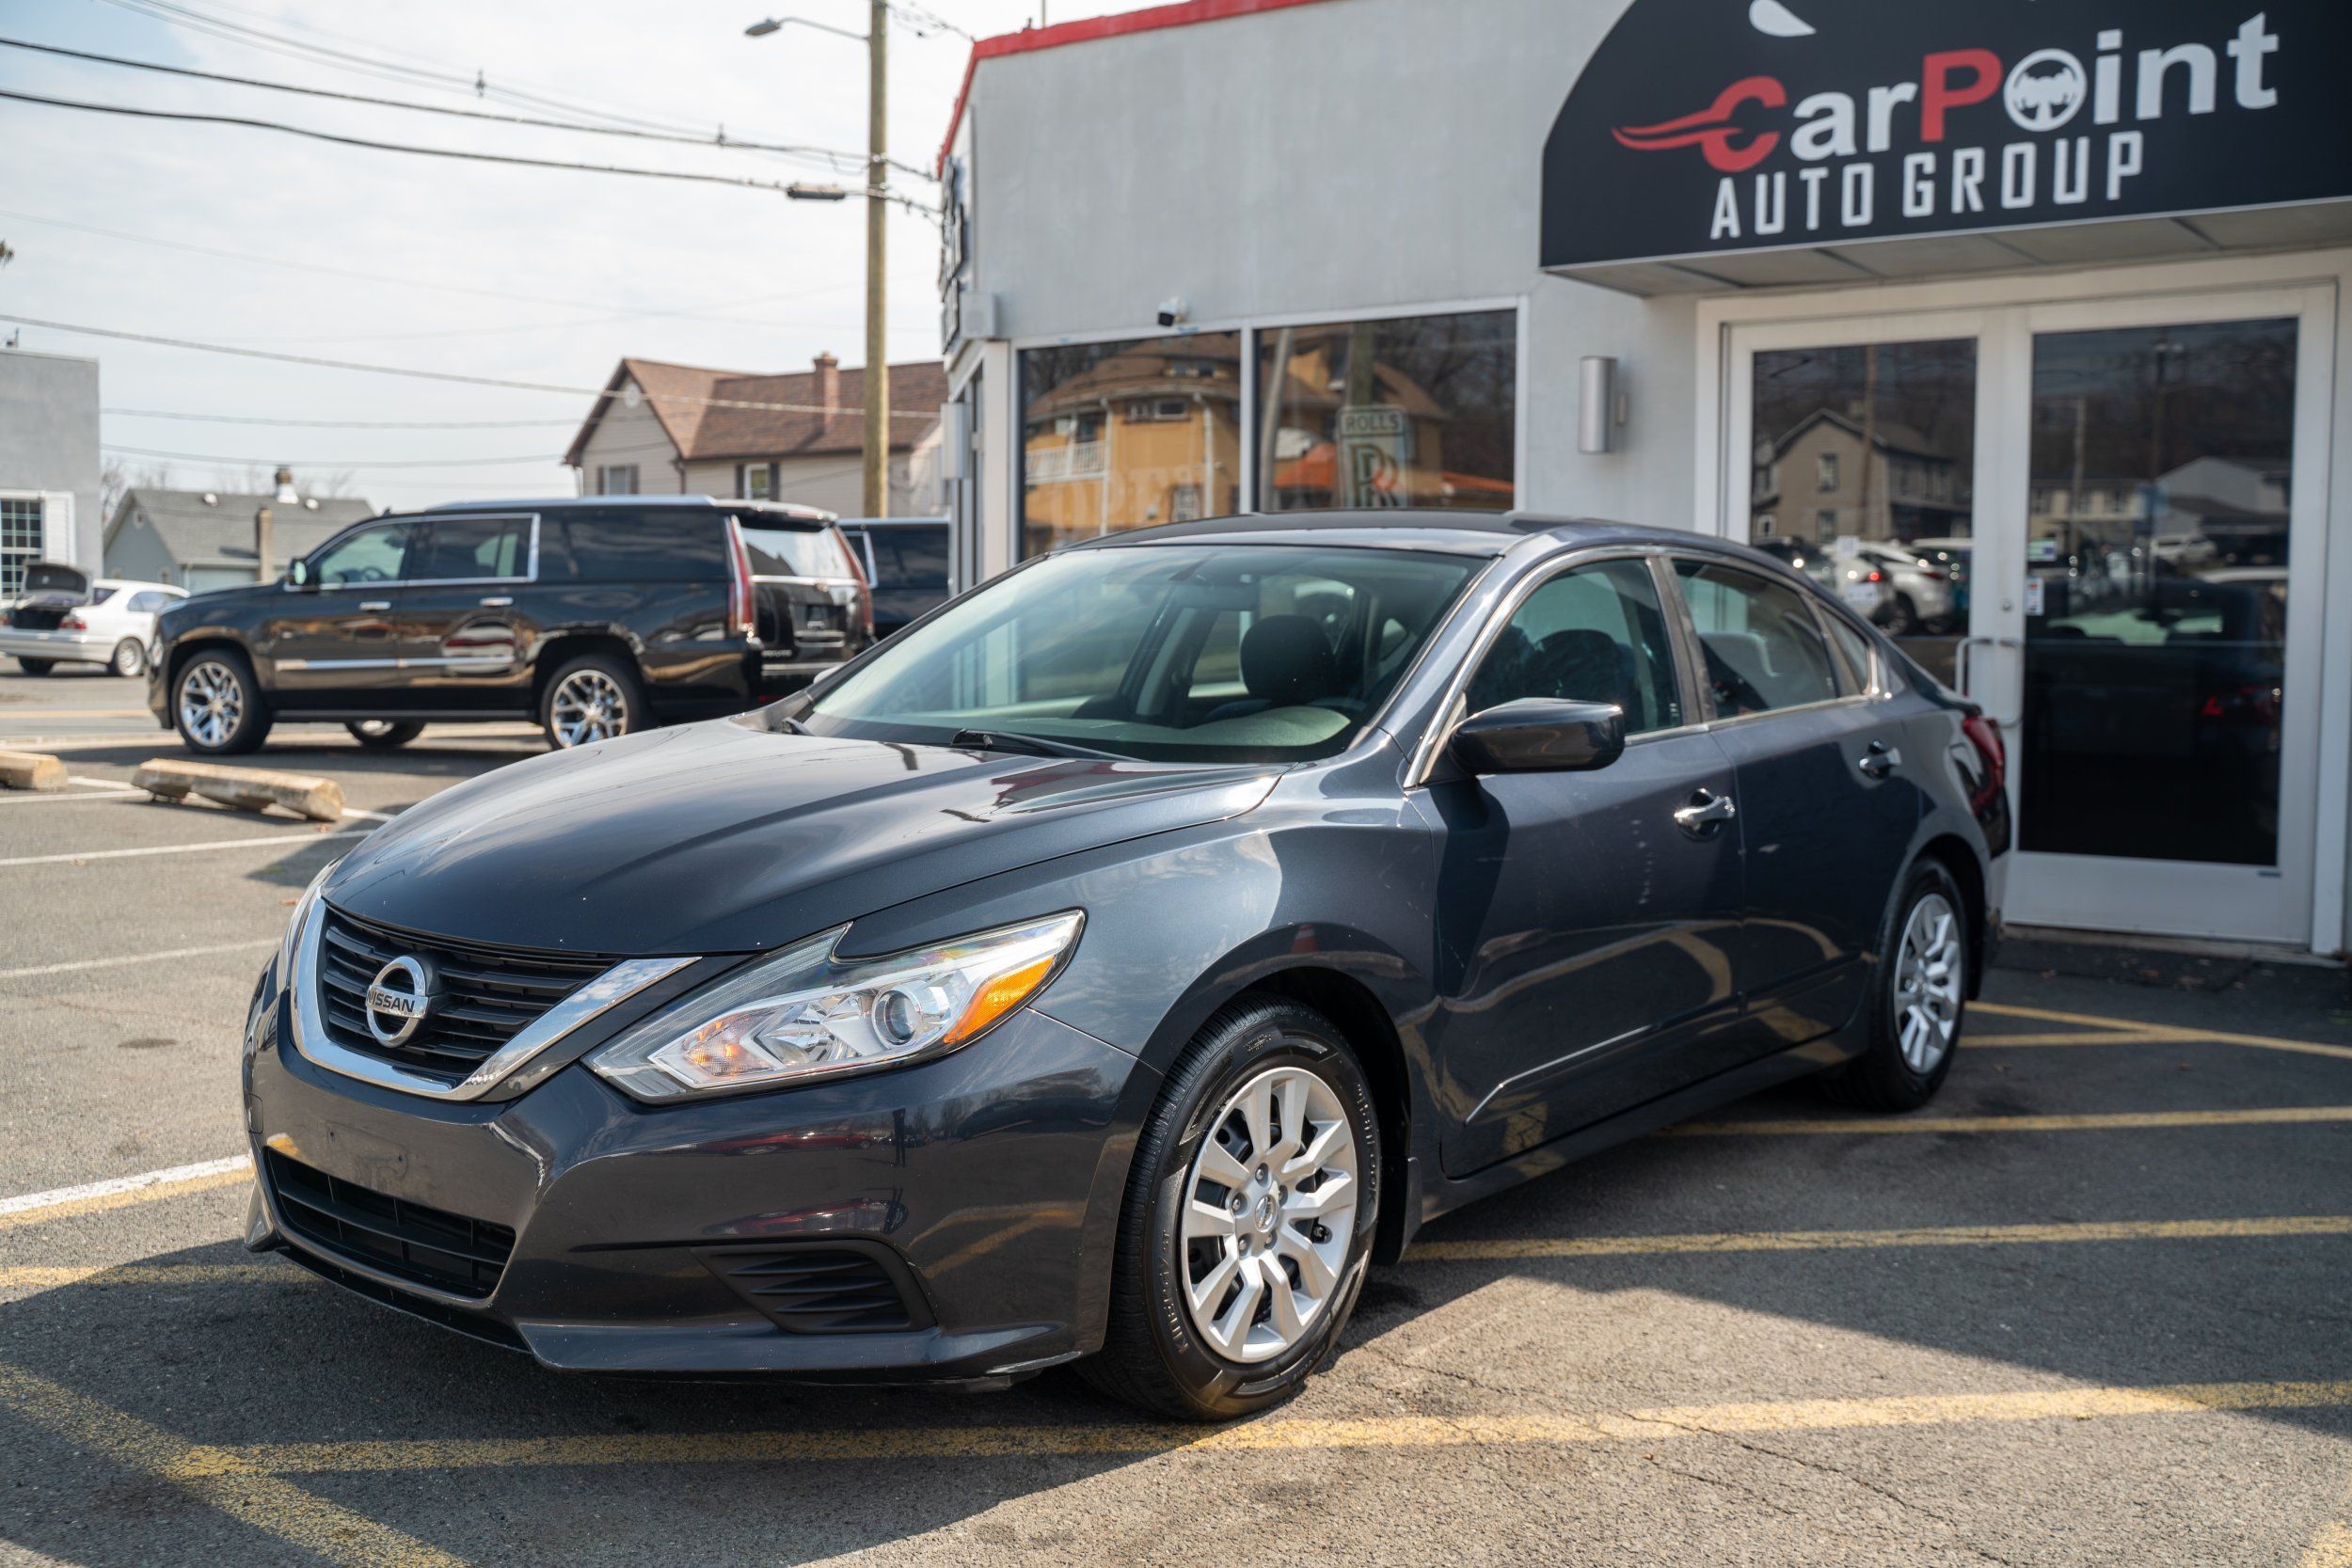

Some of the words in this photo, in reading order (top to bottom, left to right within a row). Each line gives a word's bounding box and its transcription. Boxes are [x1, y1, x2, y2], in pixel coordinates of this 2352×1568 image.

[1611, 12, 2279, 172] CarPoint
[1709, 162, 1874, 240] AUTO
[1902, 131, 2143, 217] GROUP
[1344, 412, 1400, 431] ROLLS
[367, 990, 415, 1012] NISSAN
